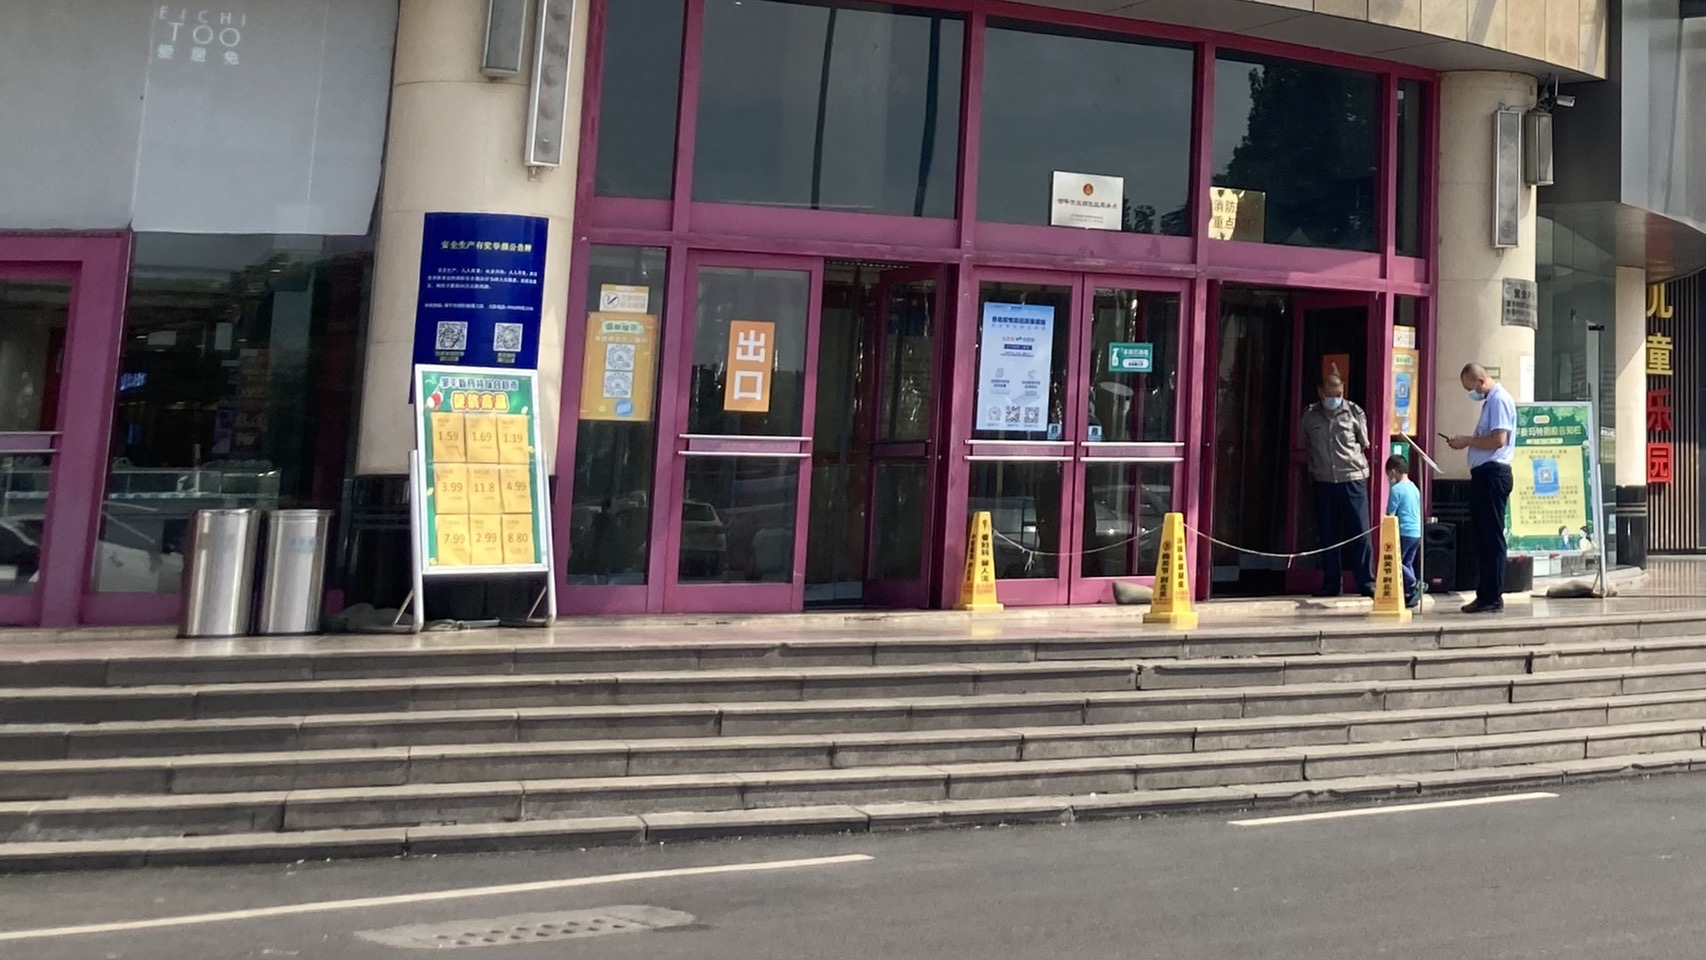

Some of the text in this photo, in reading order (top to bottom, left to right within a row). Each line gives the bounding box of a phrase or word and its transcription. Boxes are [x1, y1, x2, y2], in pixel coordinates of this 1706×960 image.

[169, 22, 240, 47] TOO
[735, 330, 766, 401] 出口
[1646, 283, 1674, 484] 儿童乐园
[439, 431, 459, 441] 1.59
[472, 431, 492, 442] 1.69
[504, 433, 523, 443] 1.19
[441, 482, 463, 492] 3.99
[474, 482, 495, 493] 11.8
[506, 481, 527, 491] 4.99
[443, 533, 465, 544] 7.99
[475, 533, 497, 543] 2.99
[507, 533, 528, 543] 8.80
